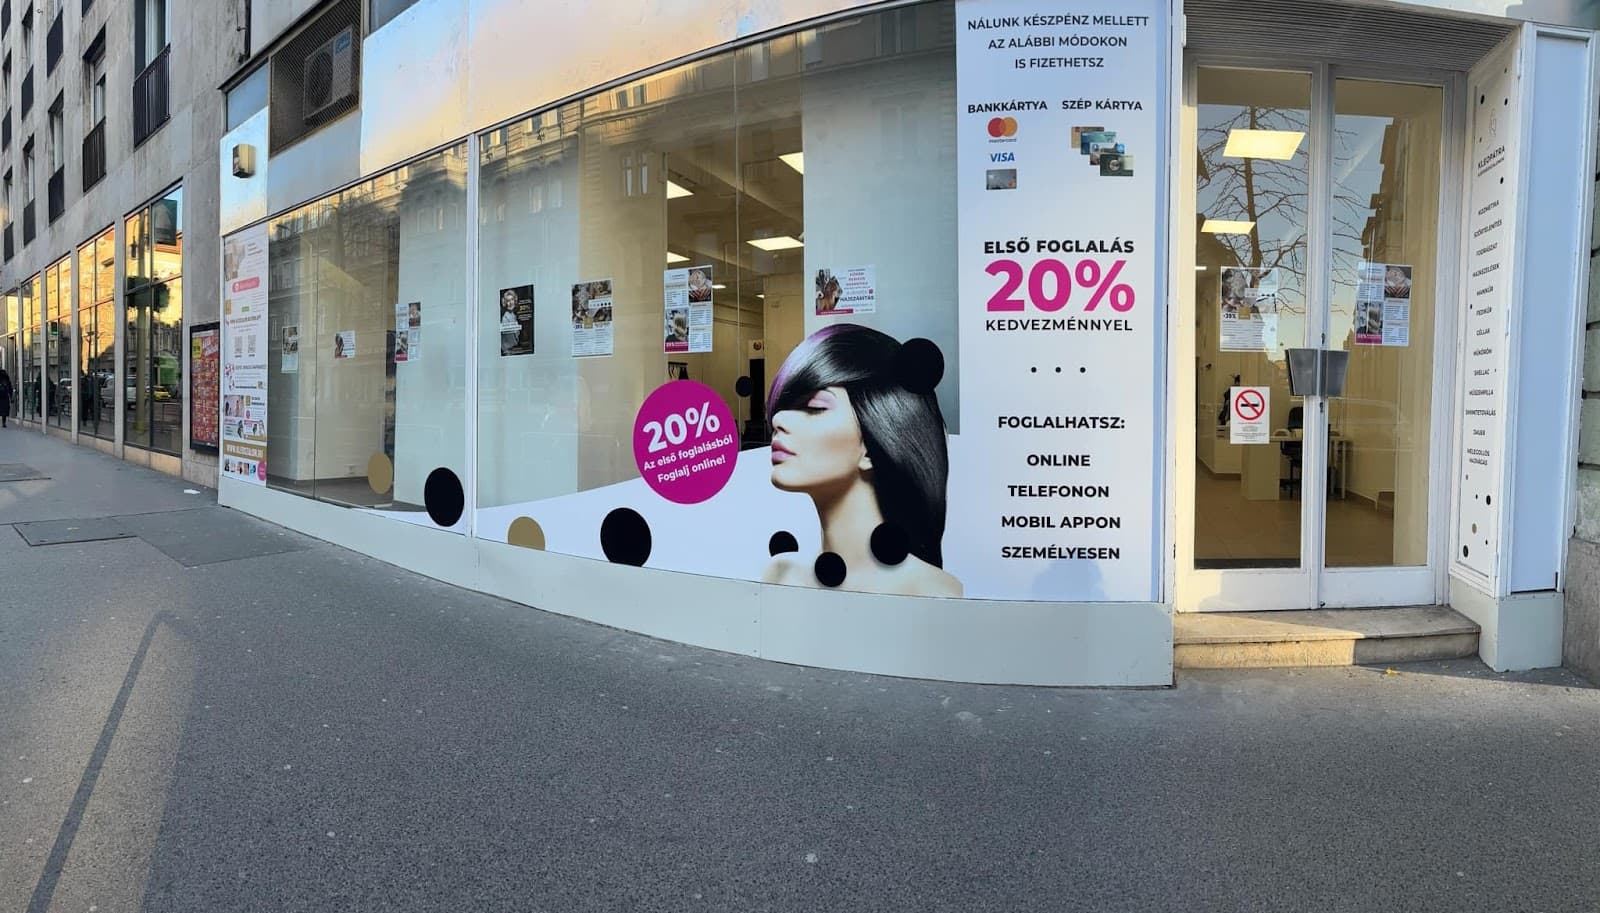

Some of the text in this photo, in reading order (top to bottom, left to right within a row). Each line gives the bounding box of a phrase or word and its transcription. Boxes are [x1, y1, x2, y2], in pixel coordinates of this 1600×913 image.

[968, 13, 1149, 30] NÁLUNK KÉSZPÉNZ MELLETT
[988, 33, 1127, 49] AZ ALÁBBI MÓDOKON
[1015, 57, 1104, 69] IS FIZETHETSZ
[968, 99, 1048, 114] BANKKÁRTYA
[1062, 98, 1143, 111] SZÉP KÁRTYA
[990, 152, 1015, 162] VISA
[984, 237, 1135, 254] ELSŐ FOGLALÁS
[985, 259, 1135, 312] 20%
[986, 316, 1133, 331] KEDVEZMÉNNYEL
[643, 401, 720, 453] 20%
[998, 416, 1125, 429] FOGLALHATSZ:
[644, 434, 733, 471] Az első foglalásból
[1027, 454, 1091, 467] ONLINE
[657, 455, 726, 483] Foglalj online!
[1008, 485, 1109, 497] TELEFONON
[1002, 516, 1121, 528] MOBIL APPON
[1002, 544, 1120, 559] SZEMÉLYESEN
